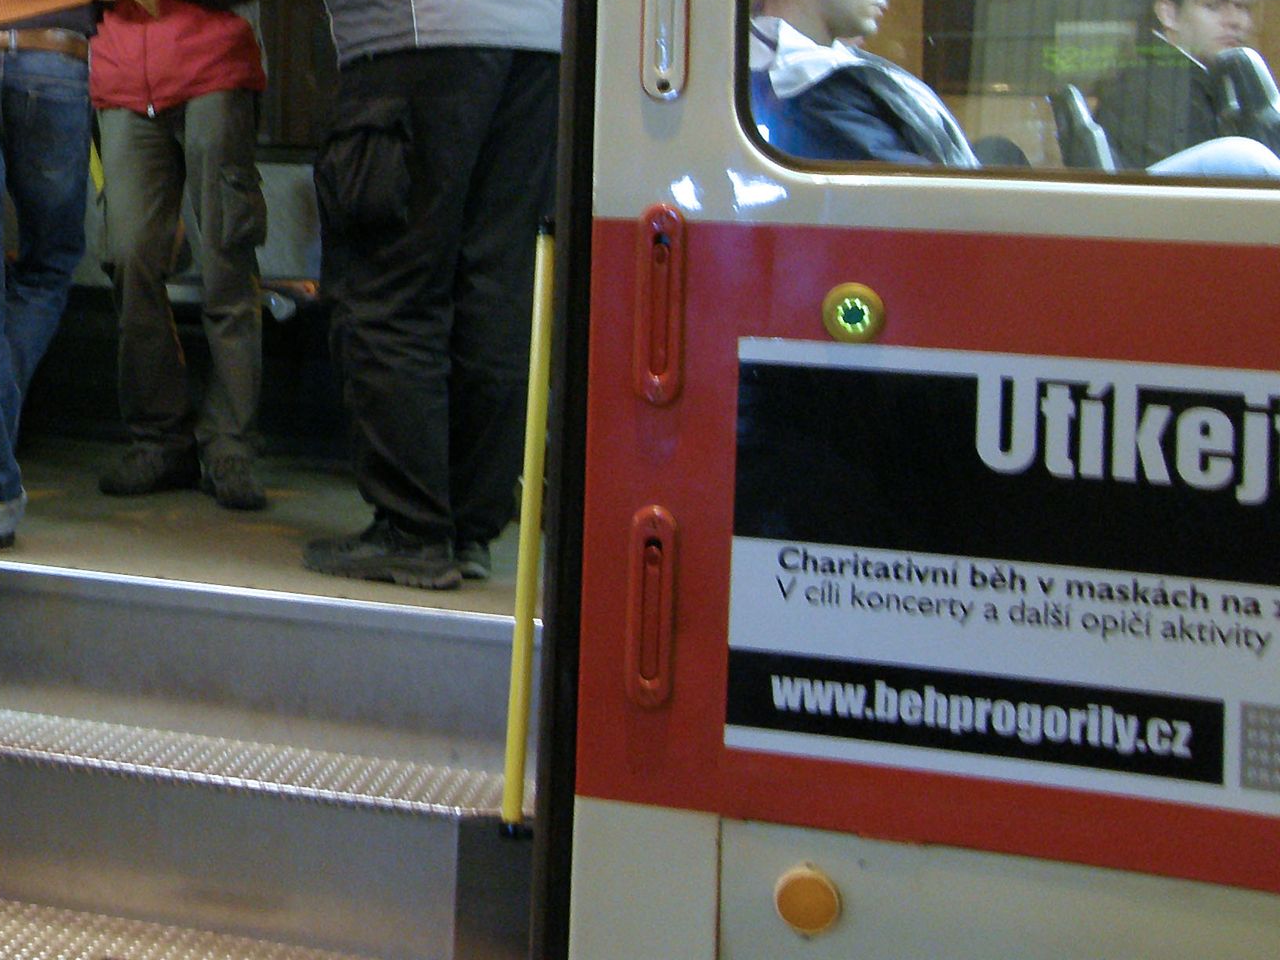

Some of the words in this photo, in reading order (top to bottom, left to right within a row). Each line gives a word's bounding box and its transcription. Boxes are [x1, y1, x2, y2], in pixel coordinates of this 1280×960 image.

[976, 374, 1280, 506] Utíkej
[776, 574, 797, 600] V
[804, 580, 841, 606] cíli
[850, 582, 974, 625] koncerty
[983, 601, 999, 621] a
[1009, 598, 1070, 628] další
[1081, 610, 1150, 638] opičí
[1160, 614, 1271, 657] aktivity
[778, 546, 959, 587] Charitativní
[970, 562, 1027, 591] běh
[1037, 576, 1055, 594] v
[1066, 577, 1209, 611] maskách
[1221, 592, 1262, 616] na
[770, 674, 1193, 759] www.behprogorily.cz
